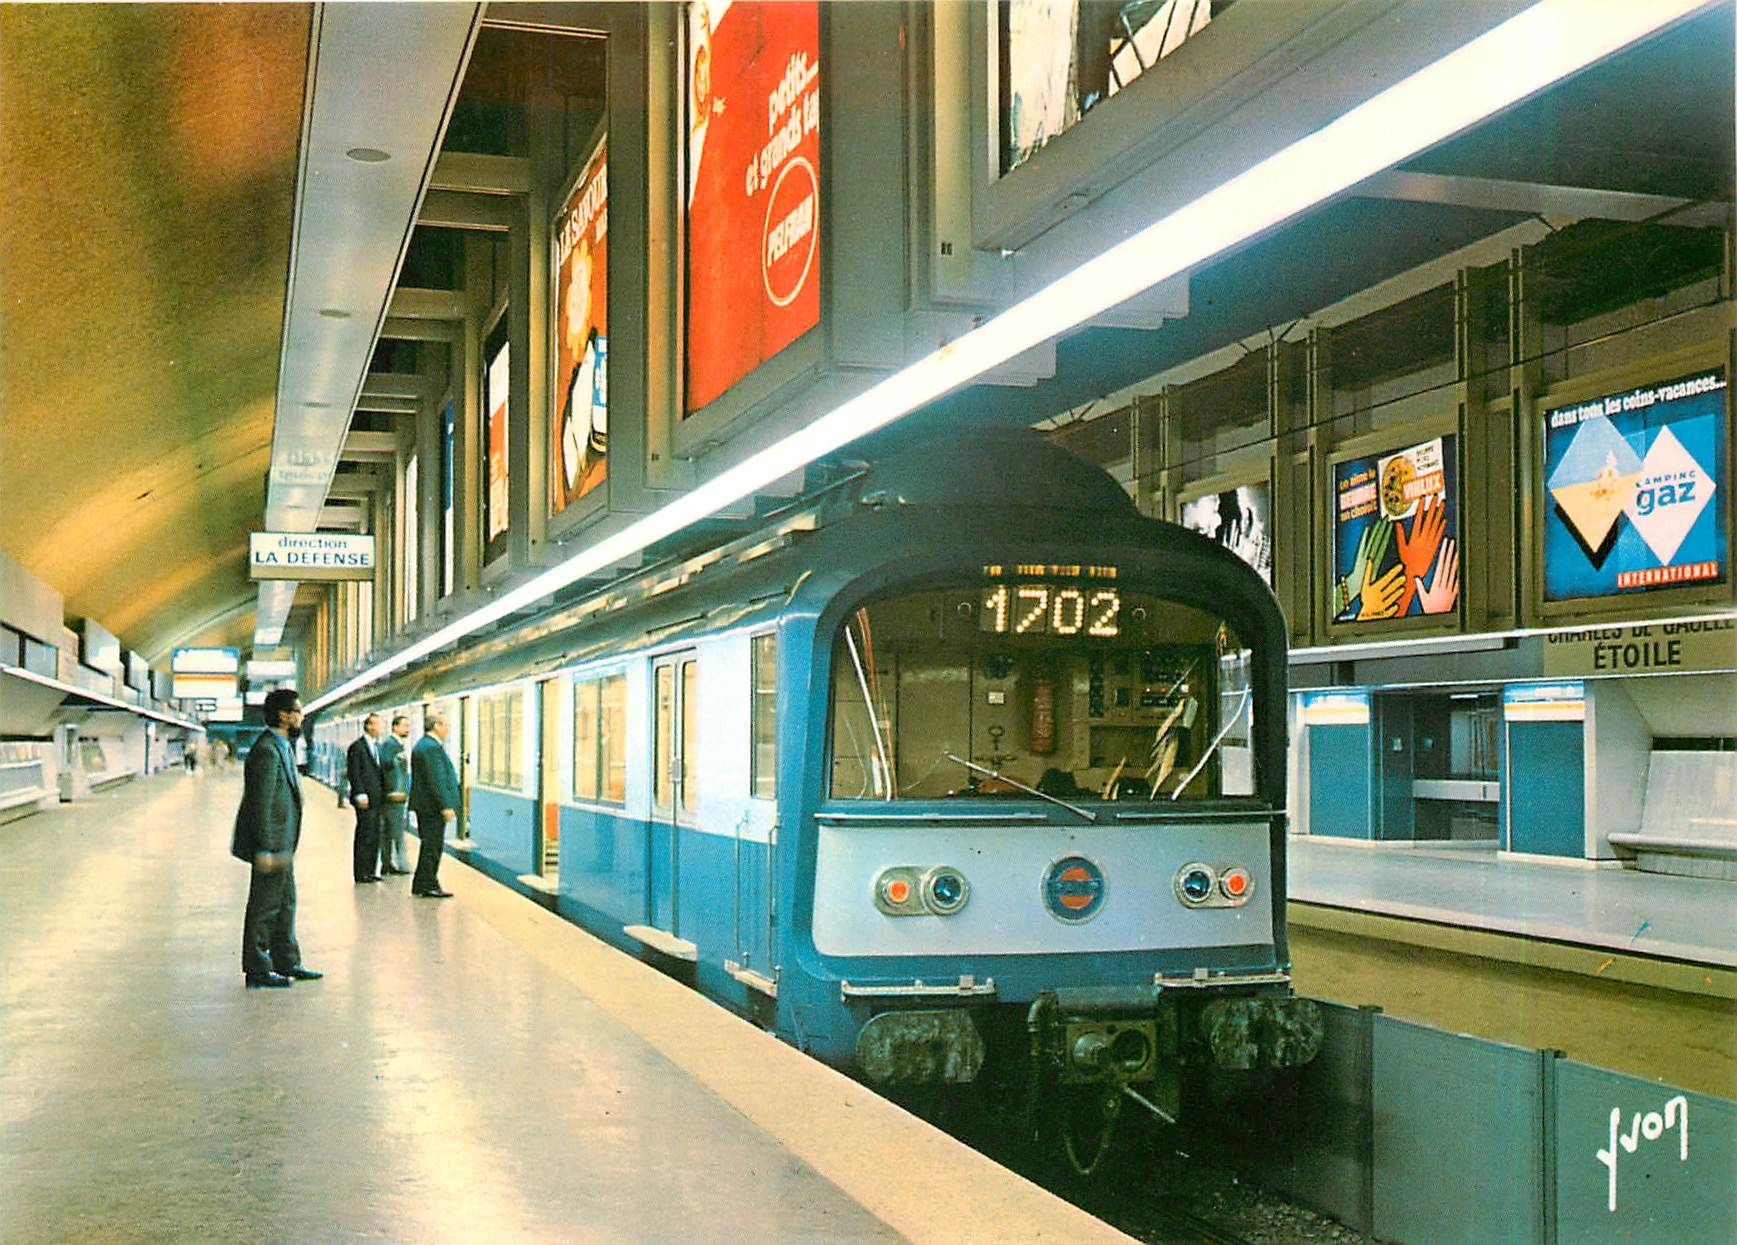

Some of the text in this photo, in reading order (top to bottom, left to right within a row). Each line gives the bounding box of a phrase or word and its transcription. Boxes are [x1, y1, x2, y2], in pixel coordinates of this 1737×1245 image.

[746, 152, 759, 196] et
[760, 105, 802, 189] grands
[1551, 408, 1577, 428] dans
[1578, 407, 1604, 423] tous
[1604, 397, 1621, 414] les
[1636, 481, 1697, 516] gaz
[255, 551, 278, 564] LA
[278, 536, 347, 549] direction
[1617, 563, 1718, 587] INTERNATIONAL
[986, 586, 1120, 636] 1702
